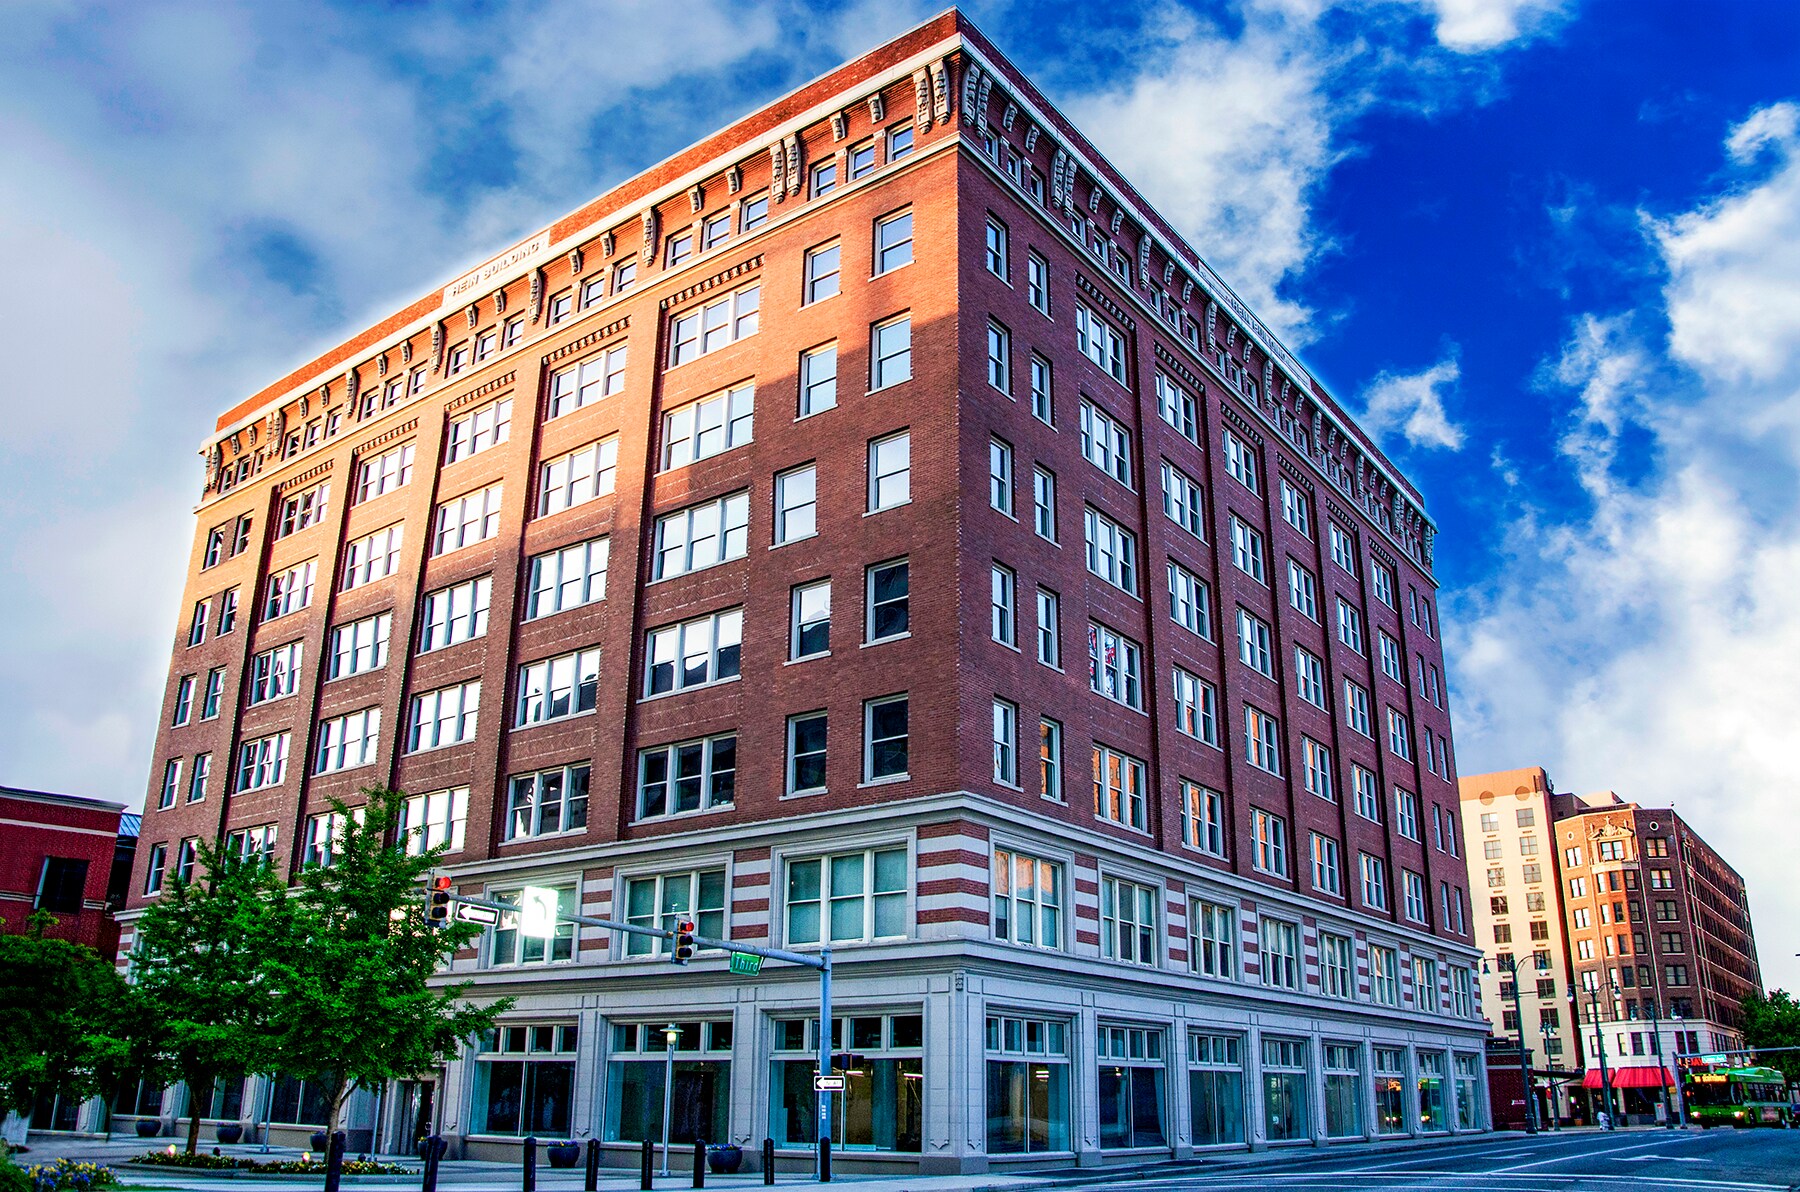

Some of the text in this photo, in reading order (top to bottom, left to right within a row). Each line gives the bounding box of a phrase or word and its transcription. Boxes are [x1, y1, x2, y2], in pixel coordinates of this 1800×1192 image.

[451, 242, 539, 297] HEIN BUILDING
[735, 956, 759, 971] Third
